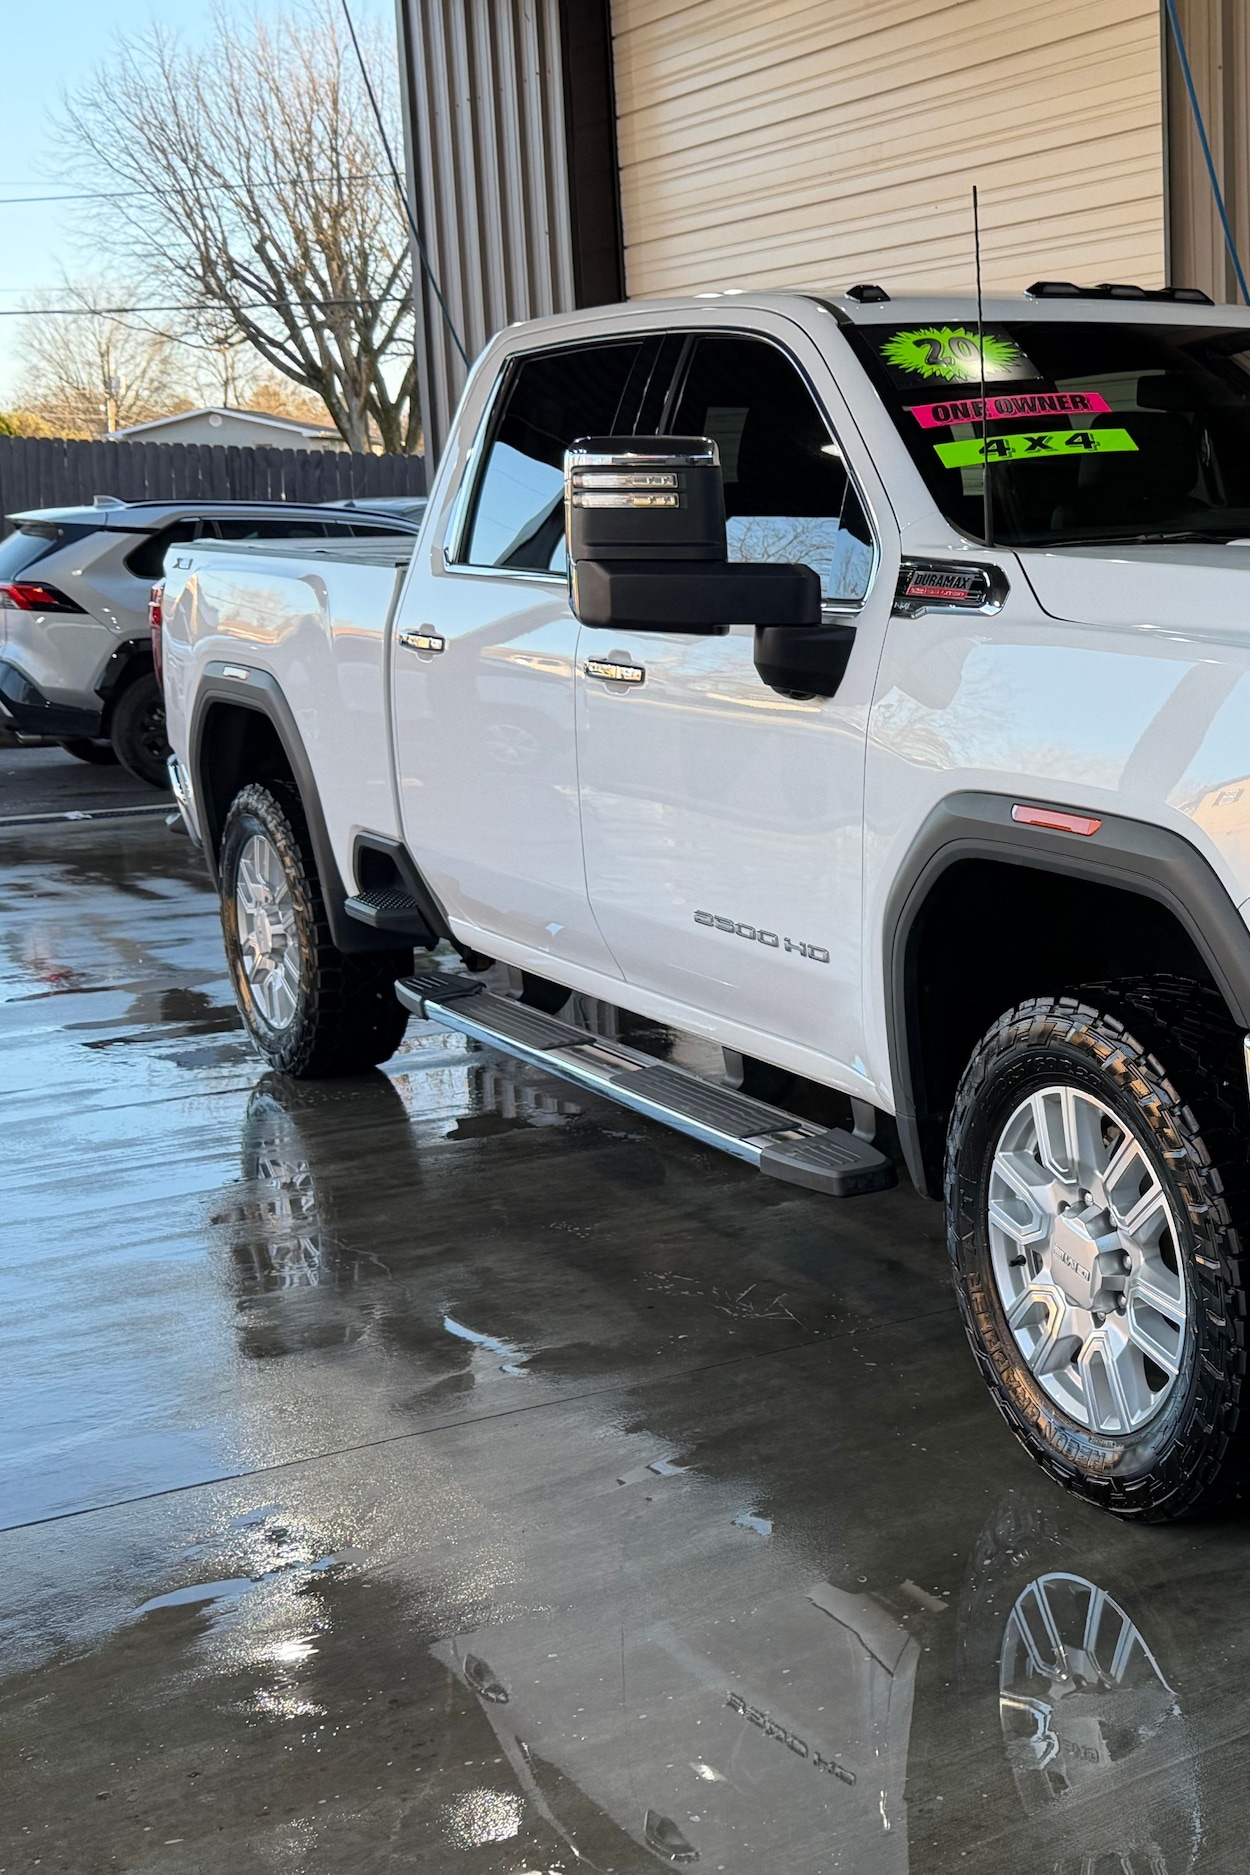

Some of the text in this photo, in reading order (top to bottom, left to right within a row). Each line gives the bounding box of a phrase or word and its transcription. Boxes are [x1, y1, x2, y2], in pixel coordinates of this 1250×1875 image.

[912, 336, 982, 366] 20
[931, 394, 1092, 423] ONE OWNER
[915, 573, 971, 589] DURAMAX
[693, 909, 831, 964] 2500 HD
